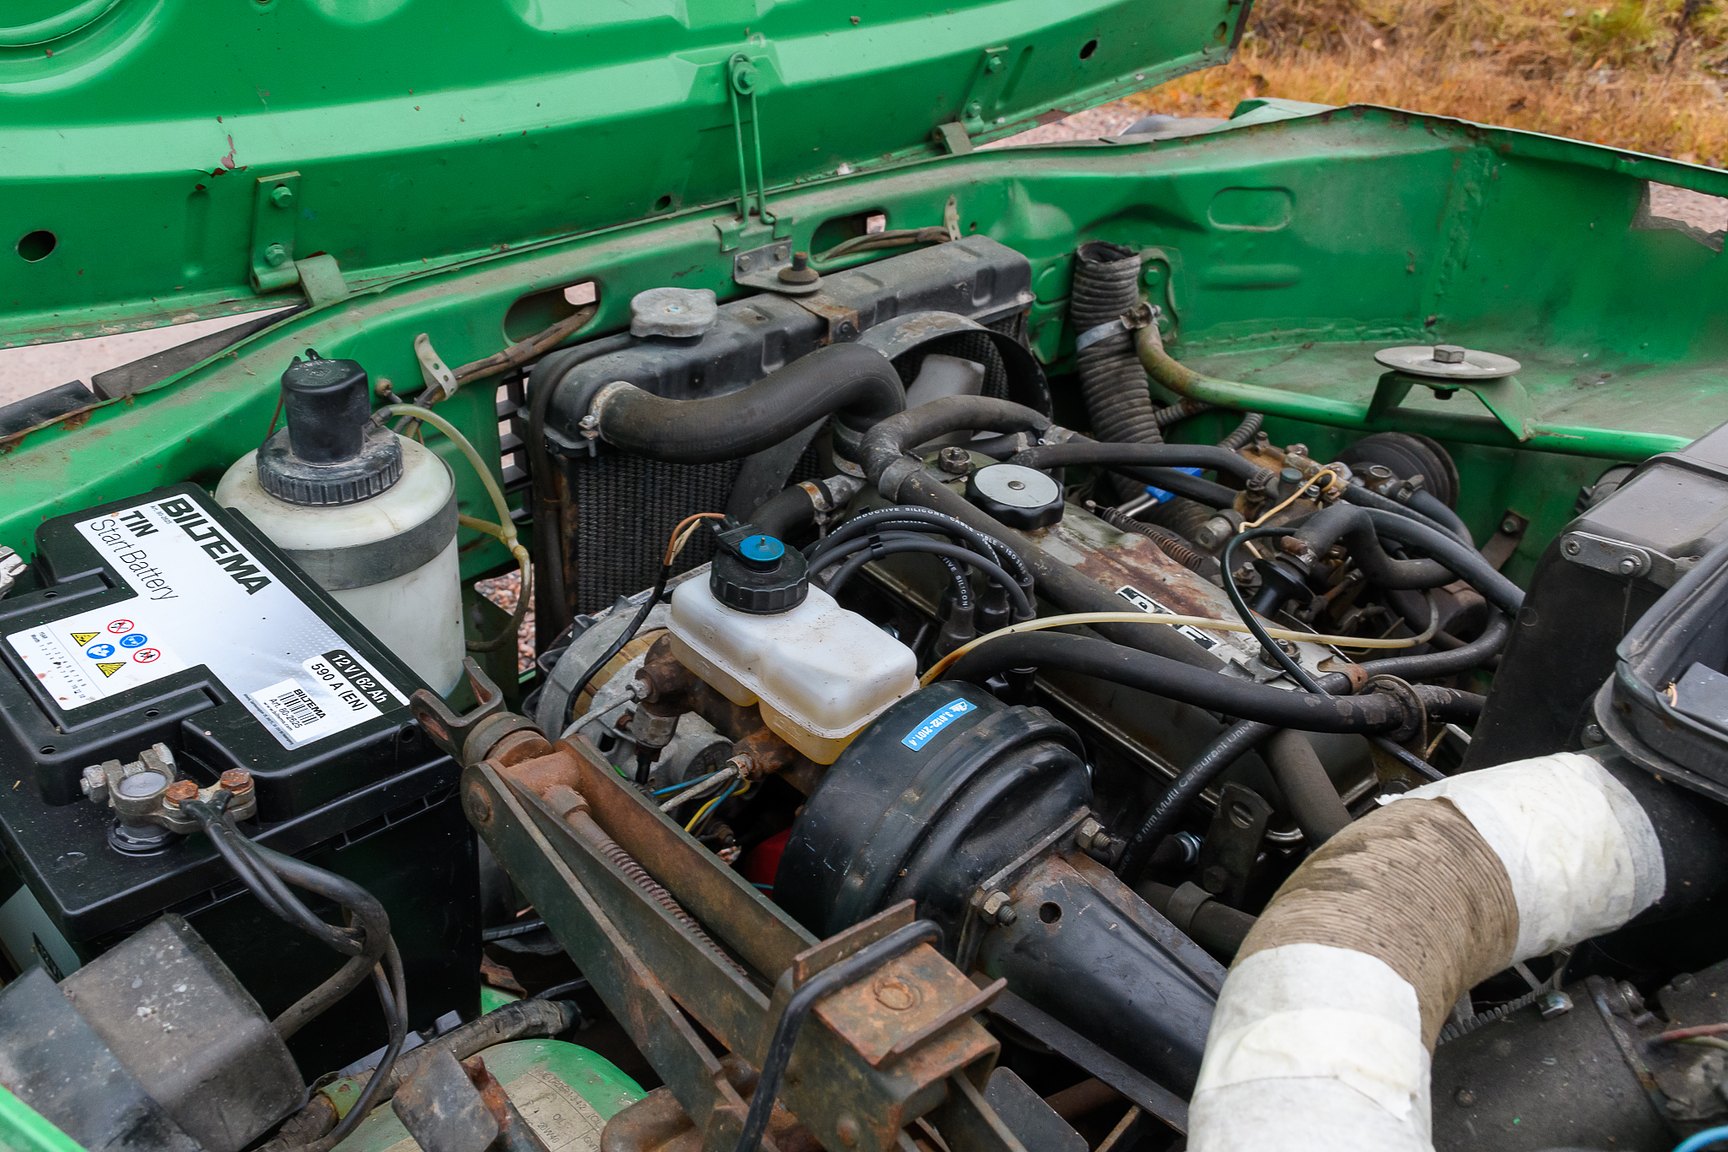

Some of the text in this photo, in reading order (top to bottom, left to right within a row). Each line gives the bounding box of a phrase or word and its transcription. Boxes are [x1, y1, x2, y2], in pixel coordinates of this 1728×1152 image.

[119, 511, 159, 538] TIN
[158, 498, 272, 596] BILTEMA
[950, 517, 974, 533] CABLE
[90, 518, 179, 600] Start Battery
[955, 575, 969, 609] SILICON
[293, 688, 326, 719] BILTEMA
[311, 662, 368, 712] 590 A (EN)
[331, 653, 347, 667] 12
[366, 690, 388, 704] Ah
[1155, 788, 1180, 815] Multi
[1178, 742, 1228, 788] Carburant
